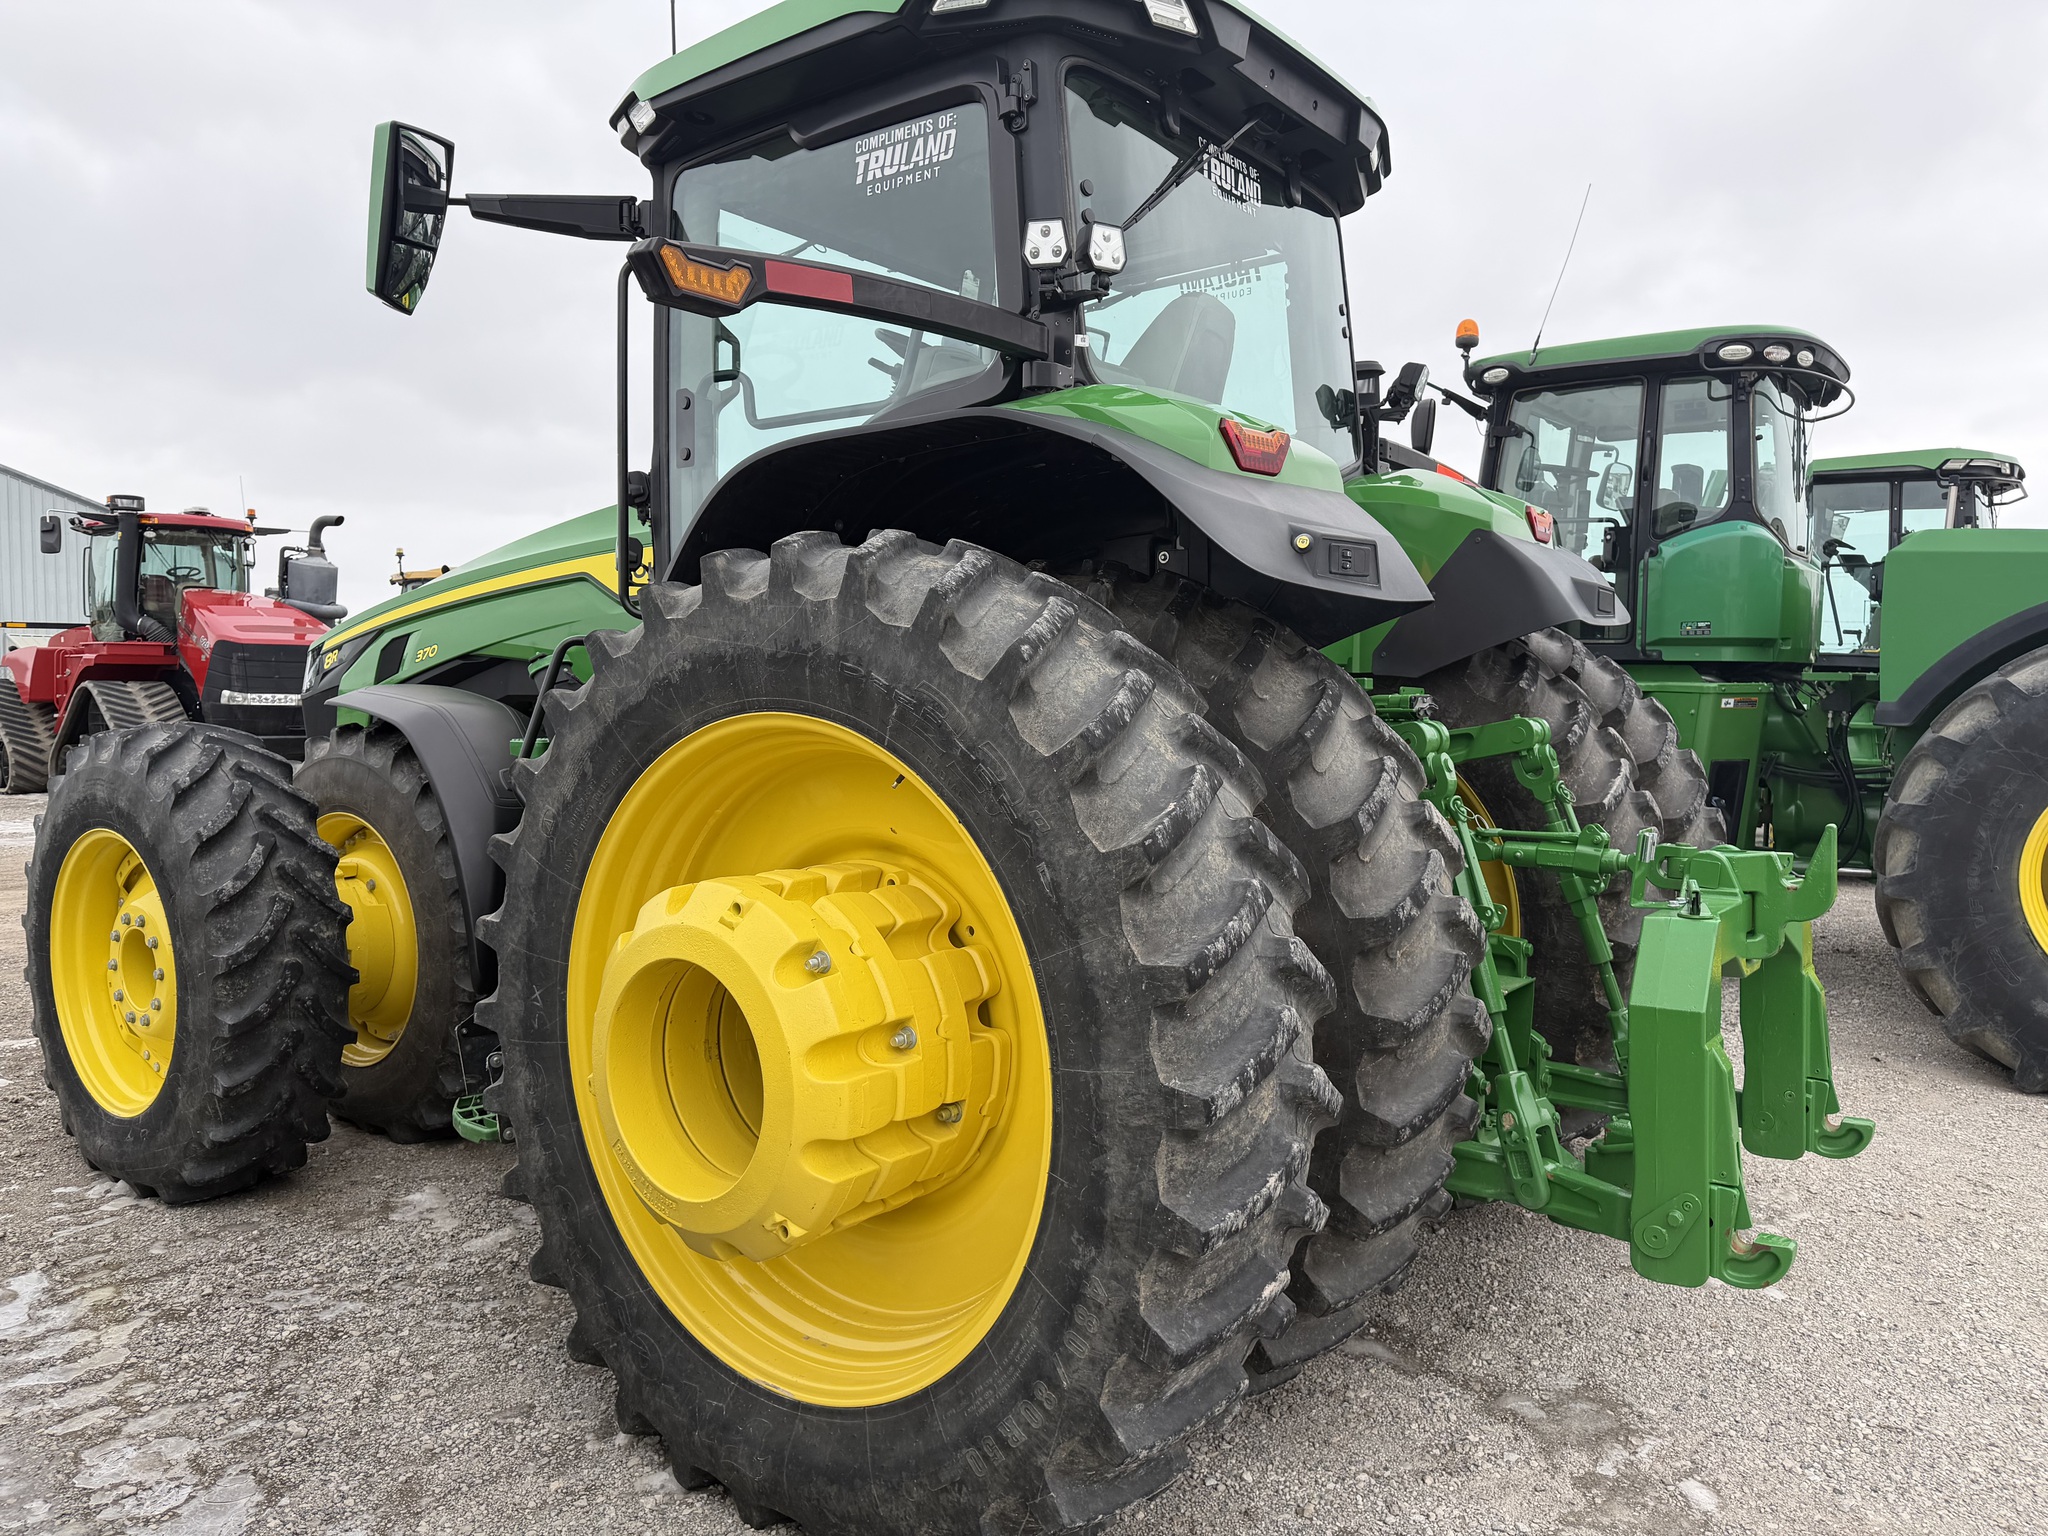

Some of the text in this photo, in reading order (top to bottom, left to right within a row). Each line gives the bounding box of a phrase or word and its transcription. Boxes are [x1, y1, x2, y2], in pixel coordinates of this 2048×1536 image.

[855, 113, 957, 154] COMPLIMENTS OF:
[855, 128, 957, 185] TRULAND
[866, 166, 940, 196] EQUIPMENT
[1202, 152, 1262, 208] TRULAND
[1249, 166, 1260, 182] OF:
[1212, 185, 1256, 217] EQUIPMENT
[323, 649, 339, 670] 8R
[415, 644, 438, 663] 370
[965, 1275, 1109, 1478] 480/80R50
